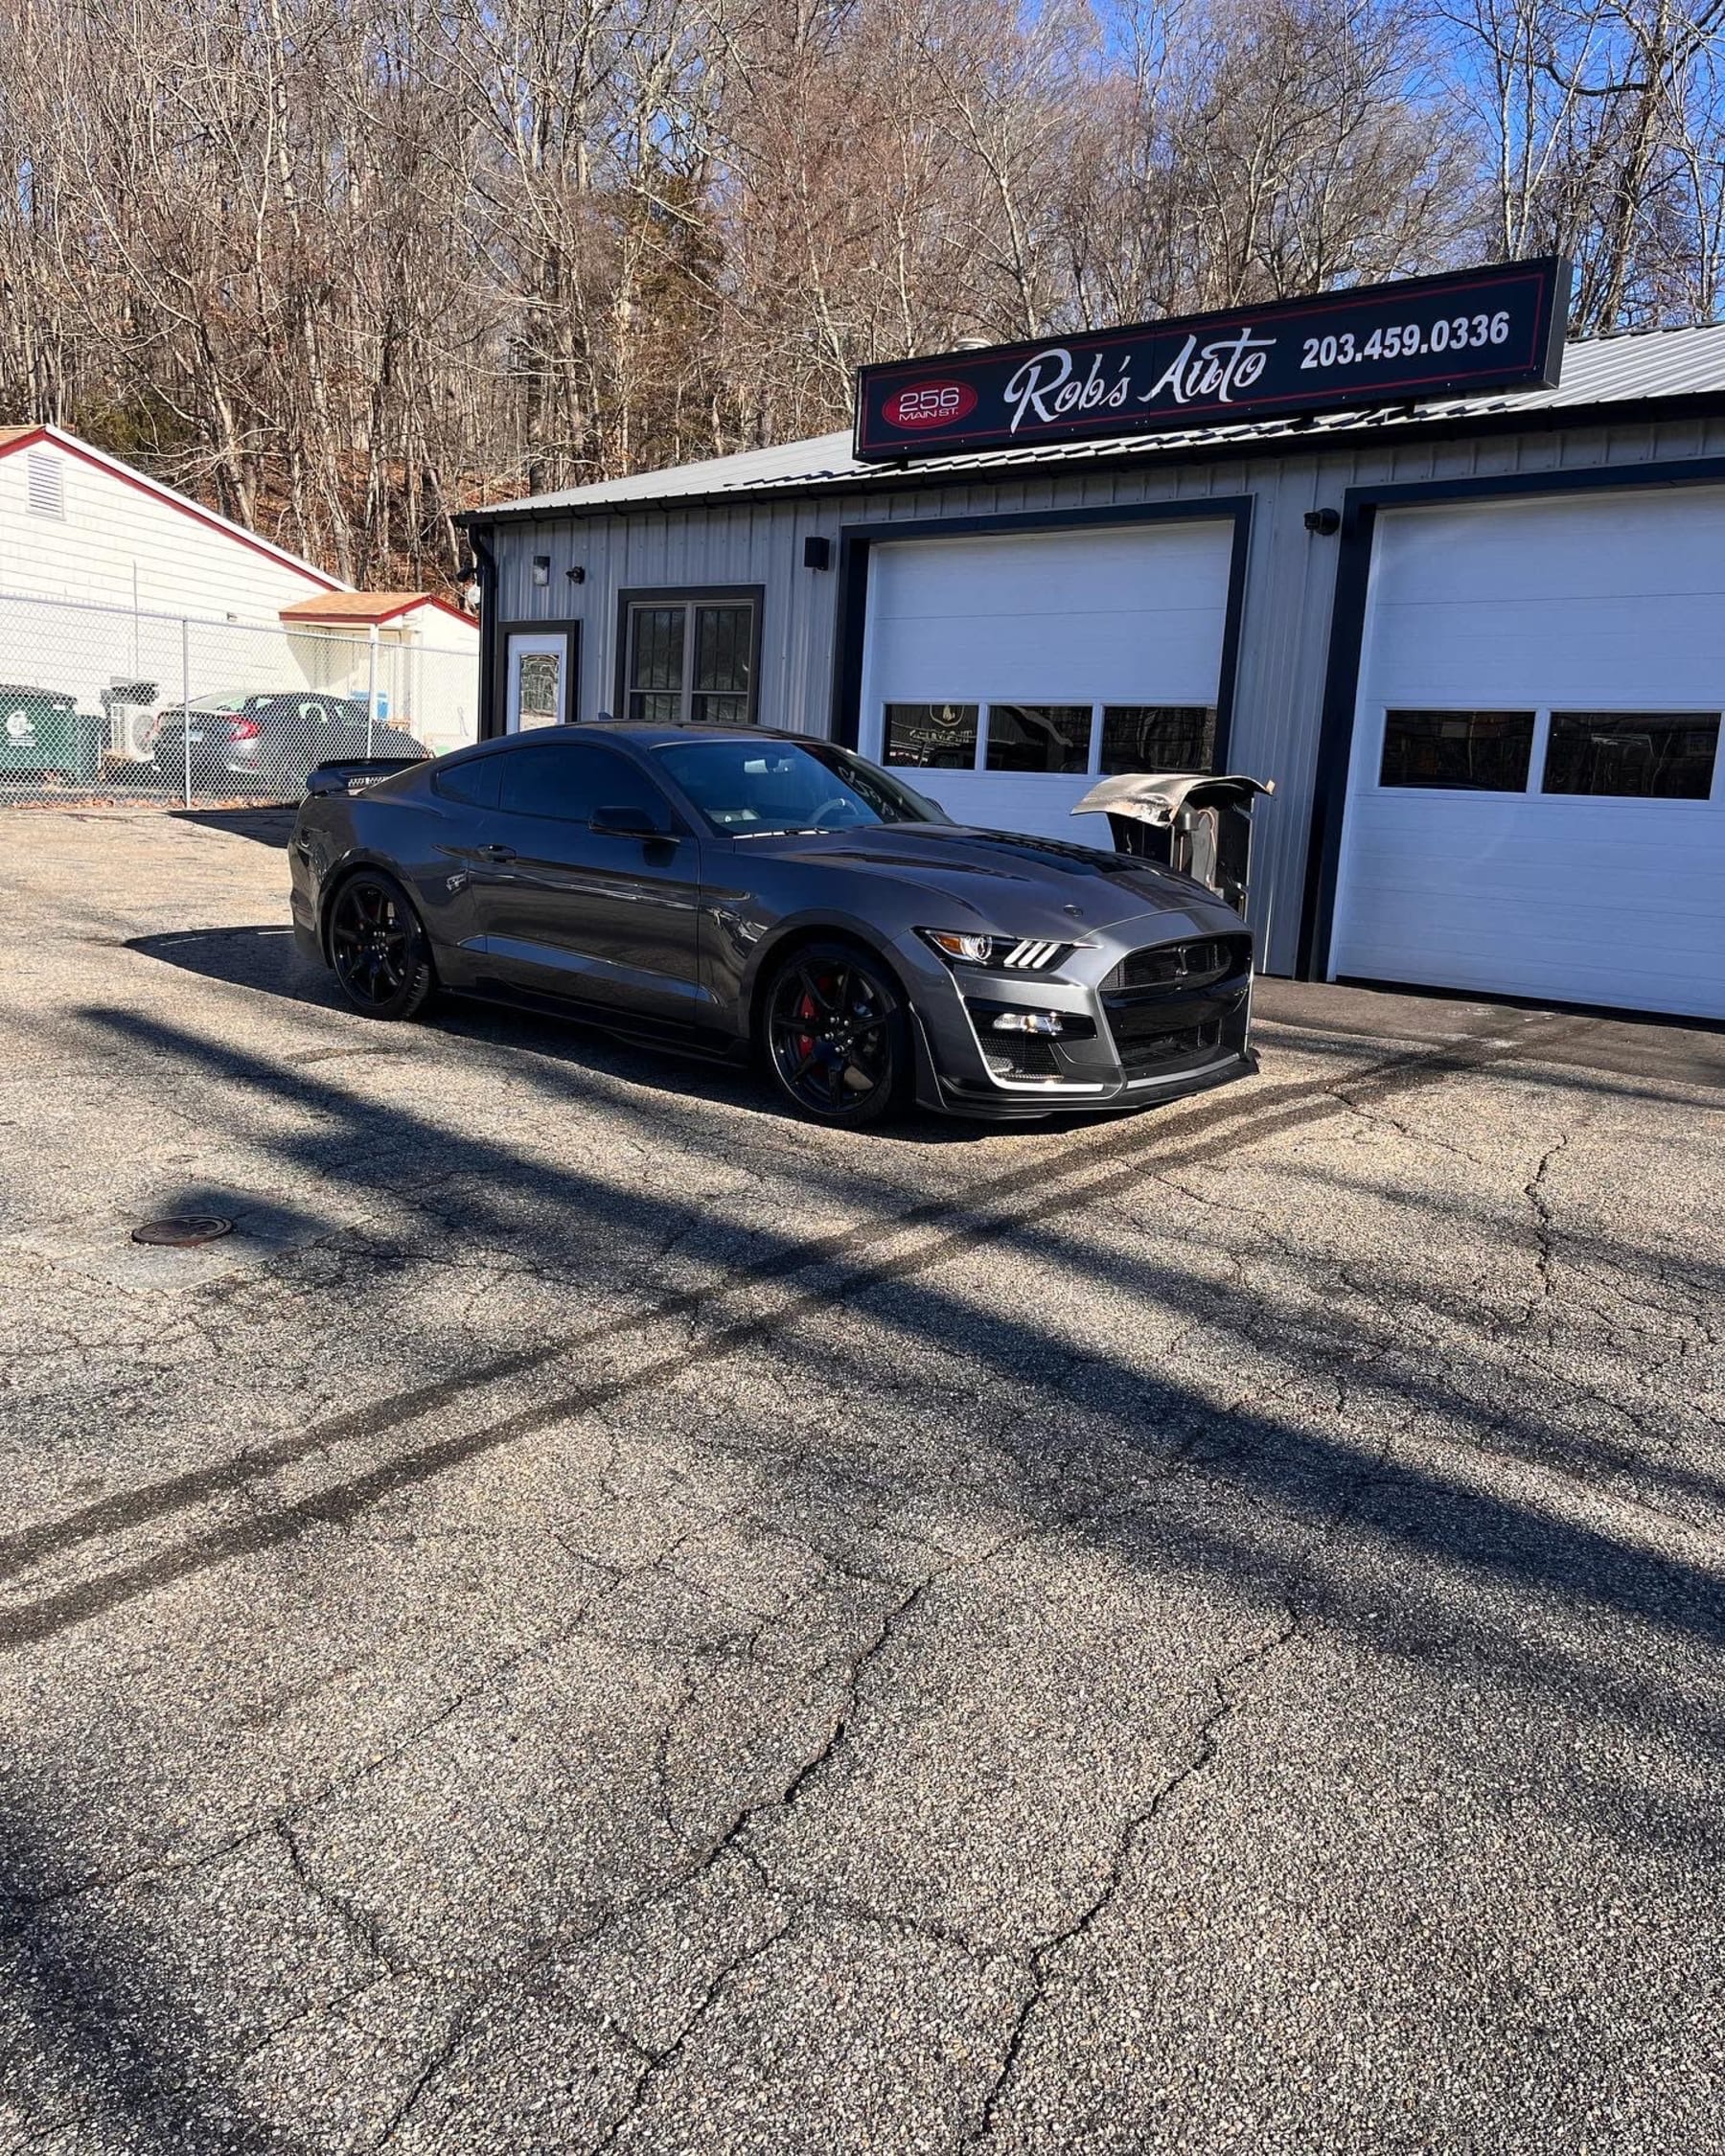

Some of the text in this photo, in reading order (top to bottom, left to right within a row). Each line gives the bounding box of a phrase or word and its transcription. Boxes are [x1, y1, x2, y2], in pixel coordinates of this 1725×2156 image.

[1300, 310, 1510, 370] 203.459.0336
[899, 387, 959, 413] 256
[1003, 328, 1277, 434] Rob's Auto
[899, 407, 959, 422] MAIN ST.
